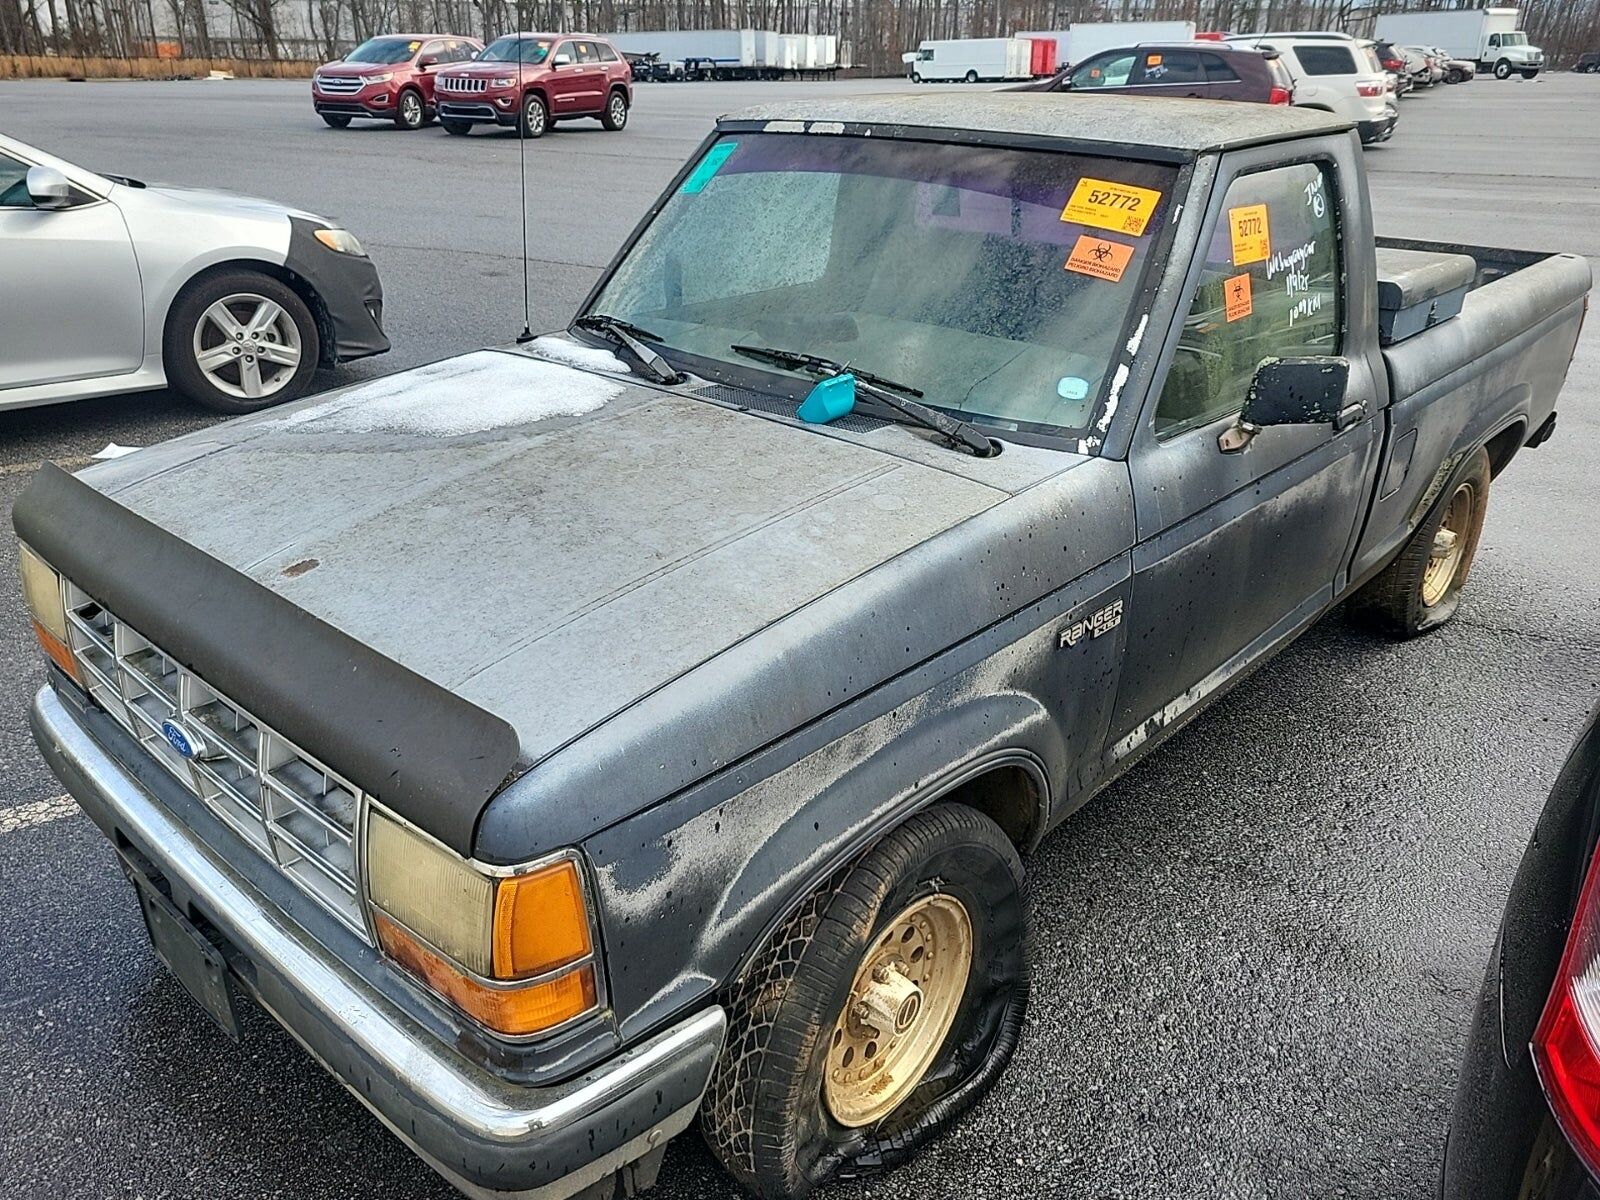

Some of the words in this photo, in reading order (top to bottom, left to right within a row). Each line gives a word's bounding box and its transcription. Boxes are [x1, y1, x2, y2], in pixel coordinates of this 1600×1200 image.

[1087, 189, 1142, 212] 52772
[1238, 217, 1263, 238] 52772
[1071, 257, 1092, 266] DANGER
[1092, 261, 1121, 273] BIOHAZARD
[1089, 267, 1119, 279] BIOHAZARD
[1059, 599, 1124, 648] RANGER
[167, 726, 187, 752] Ford
